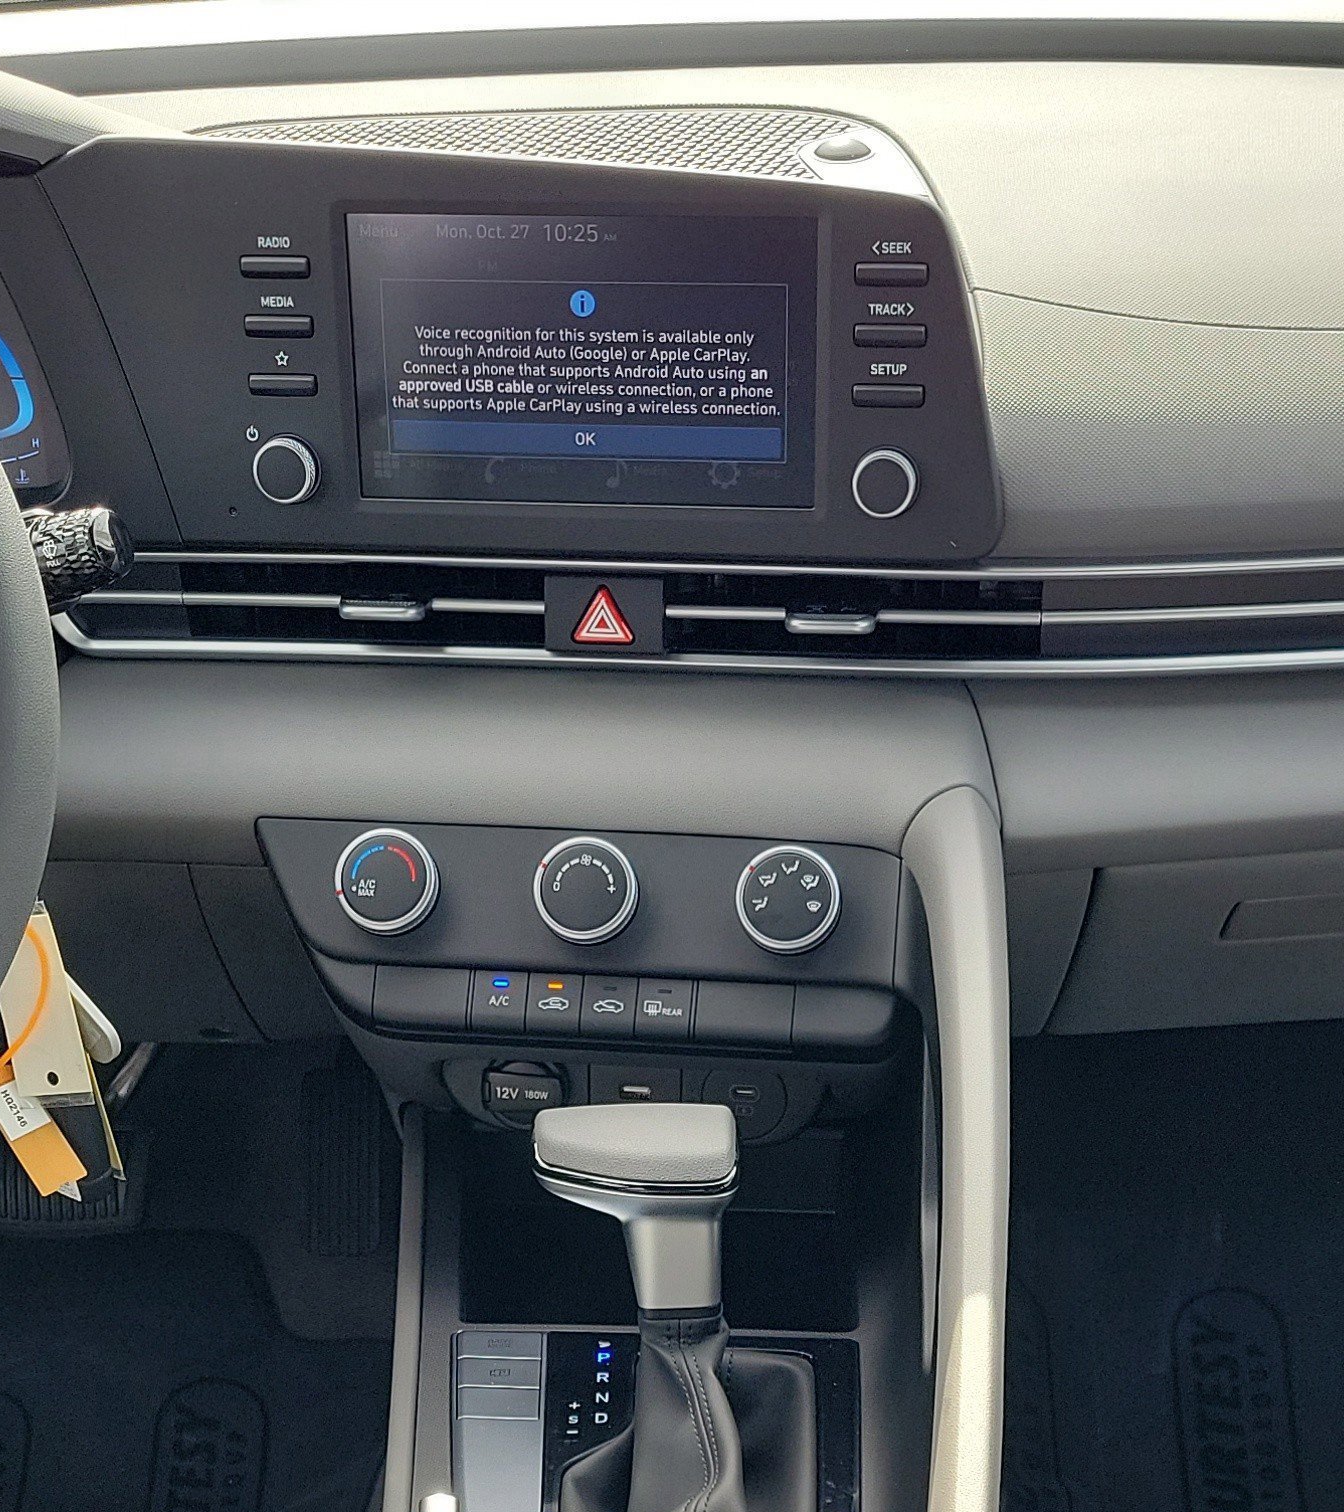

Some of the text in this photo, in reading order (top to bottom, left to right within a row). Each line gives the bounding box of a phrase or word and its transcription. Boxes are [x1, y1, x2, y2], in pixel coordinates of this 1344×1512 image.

[476, 224, 505, 240] Oct.
[510, 225, 529, 239] 27
[543, 224, 598, 242] 10:25
[257, 236, 290, 249] RADIO
[260, 296, 294, 308] MEDIA
[415, 326, 754, 346] Voice recognition for this system is available only
[419, 344, 750, 365] through Android Auto (Google) or Apple CarPlay.
[403, 361, 768, 383] Connect a phone that supports Android Auto using an
[870, 363, 907, 376] SETUP
[399, 379, 774, 400] approved USB cable or wireless connection, or a phone
[392, 395, 781, 417] that supports Apple CarPlay using a wireless connection.
[32, 438, 40, 448] H
[574, 432, 597, 447] OK
[358, 879, 376, 889] A/C
[357, 889, 375, 897] MAX
[488, 995, 510, 1007] A/C
[661, 1007, 683, 1017] REAR
[495, 1086, 549, 1100] 12V 180W
[0, 1089, 28, 1128] HQ2146
[597, 1352, 611, 1363] P
[596, 1372, 610, 1383] R
[595, 1392, 610, 1404] N
[568, 1415, 579, 1424] S
[594, 1412, 609, 1424] D
